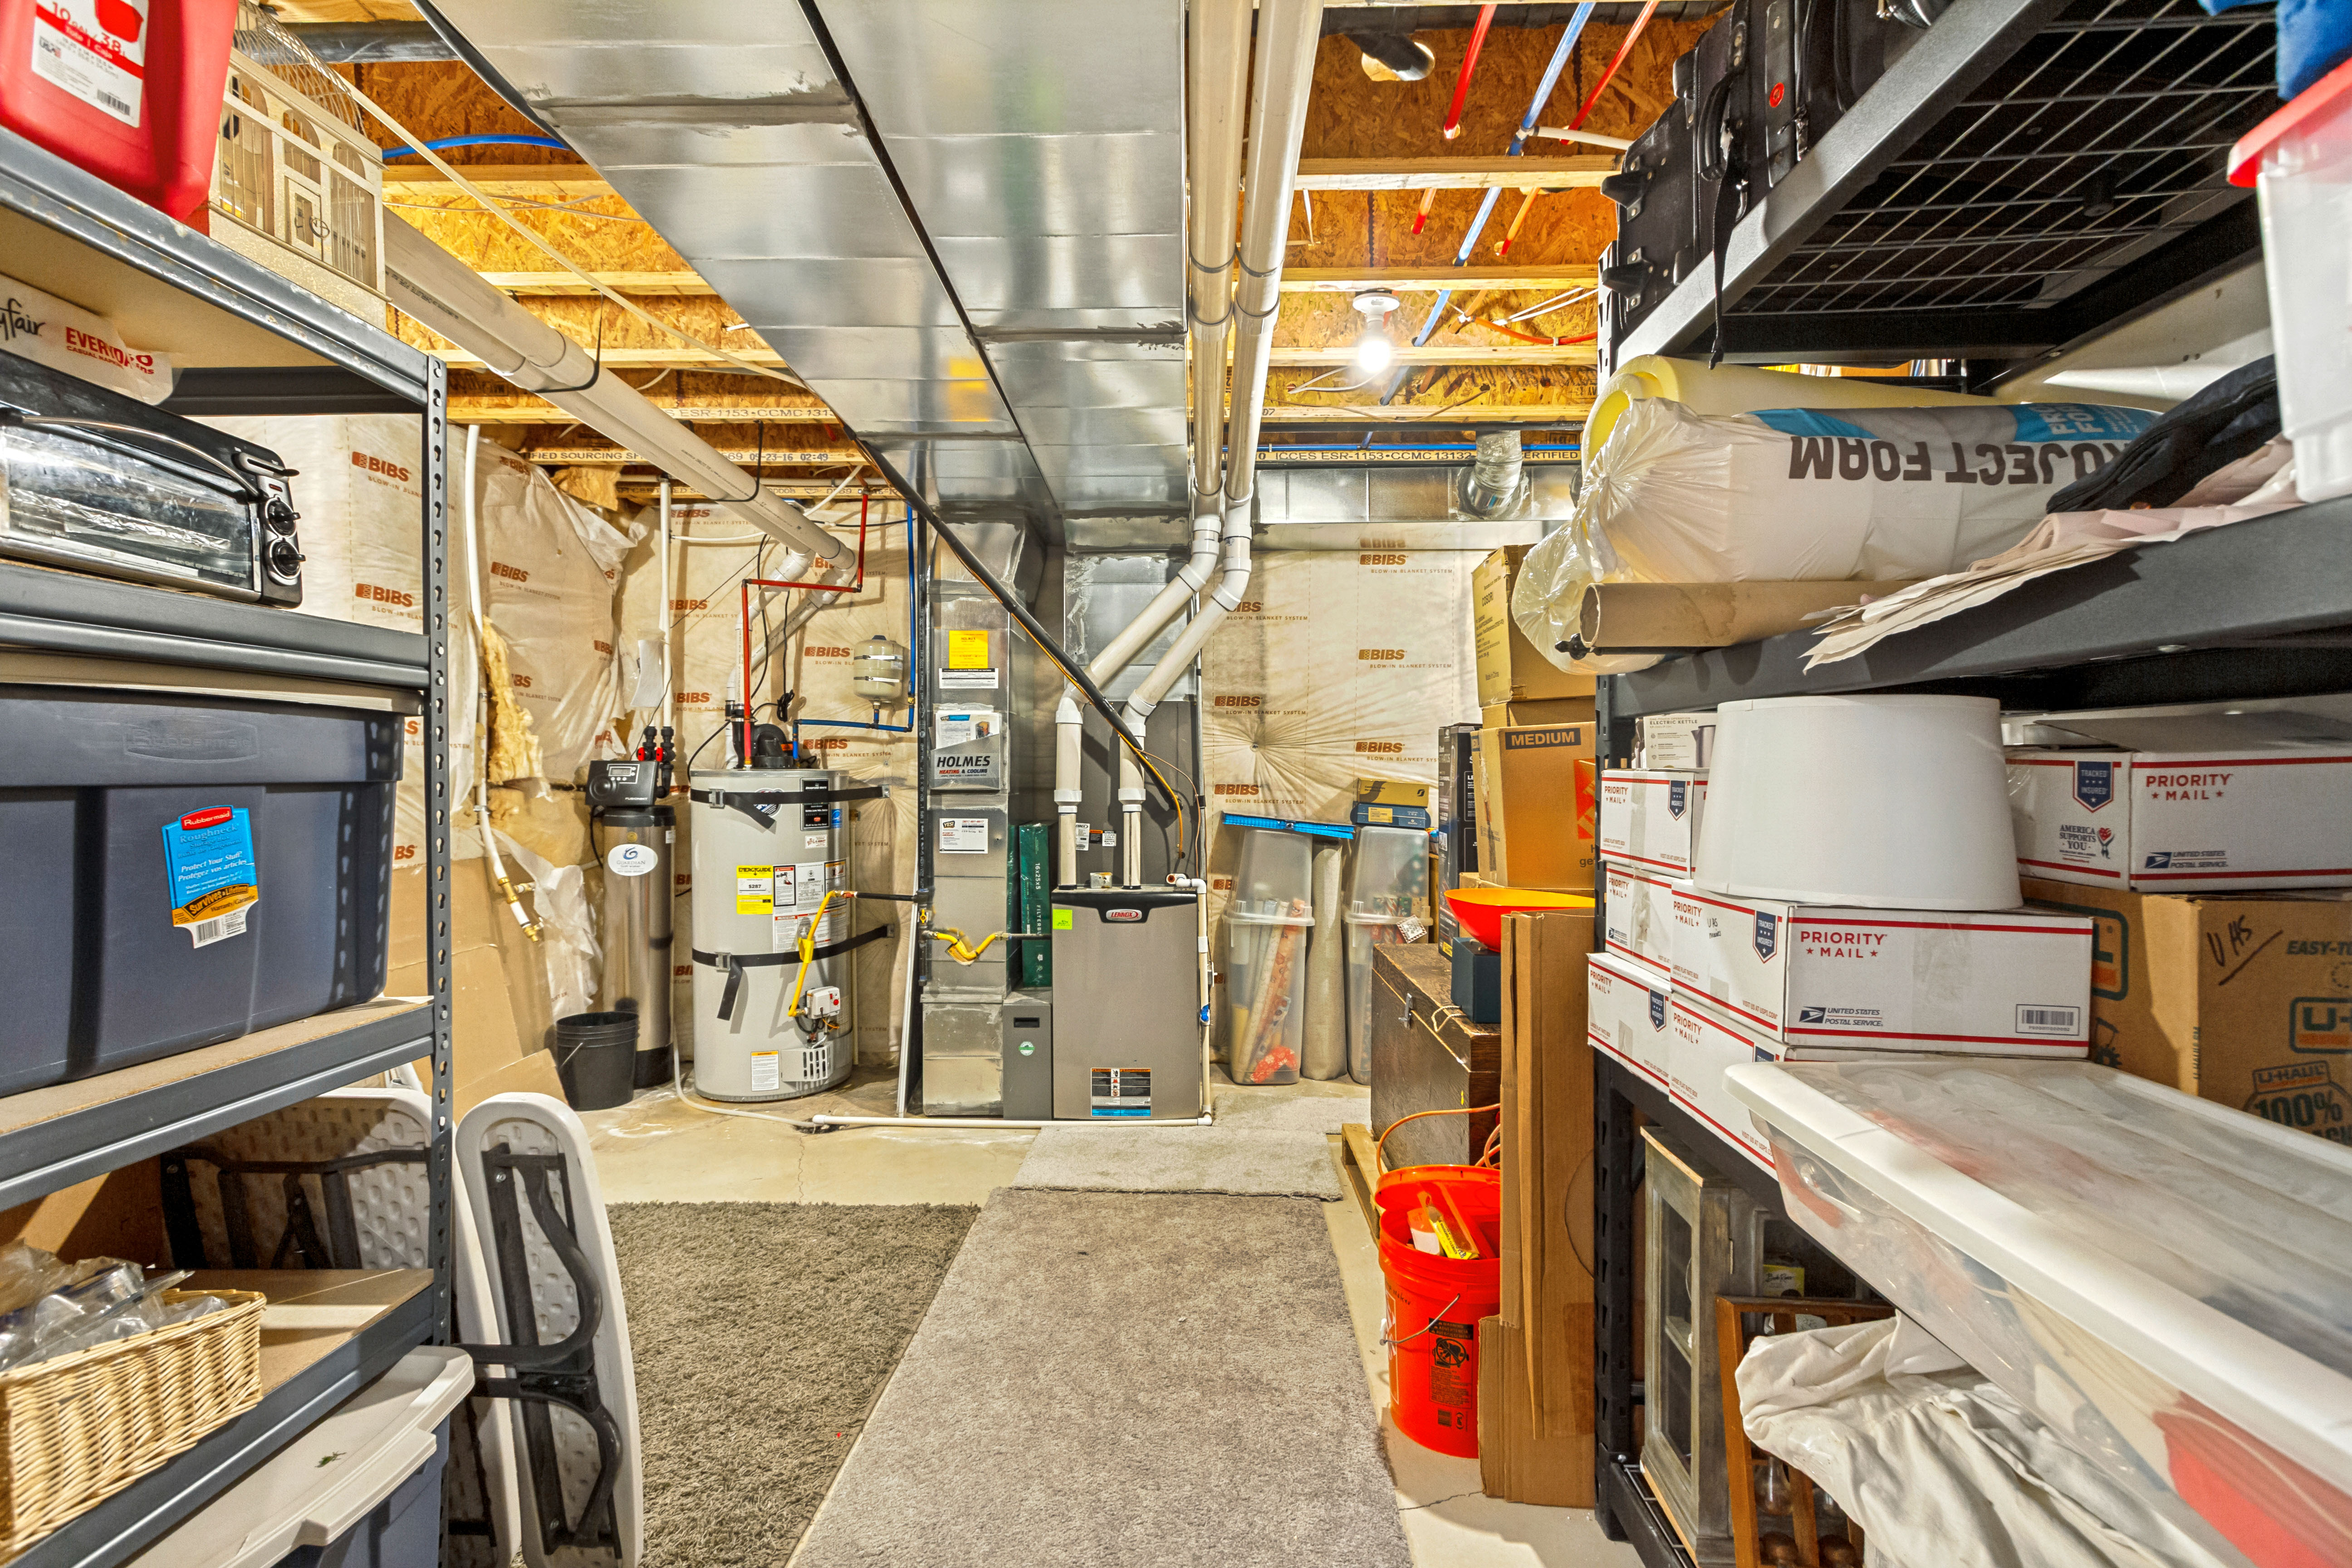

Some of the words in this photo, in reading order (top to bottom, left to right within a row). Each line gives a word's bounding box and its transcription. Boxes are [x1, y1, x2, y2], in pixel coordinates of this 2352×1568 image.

[800, 453, 828, 461] 02:49
[1392, 452, 1433, 460] CCMC
[1789, 436, 1933, 482] FOAM
[368, 456, 410, 482] BIBS
[368, 475, 400, 490] BLOW-IN
[677, 510, 710, 518] BIBS
[1371, 554, 1406, 565] BIBS
[500, 564, 529, 583] BIBS
[372, 585, 413, 608] BIBS
[676, 599, 708, 610] BIBS
[372, 606, 404, 617] BLOW-IN
[816, 647, 850, 657] BIBS
[1370, 649, 1405, 660] BIBS
[676, 693, 710, 703] BIBS
[1225, 696, 1260, 707] BIBS
[813, 739, 848, 749] BIBS
[1511, 731, 1575, 746] MEDIUM
[1368, 742, 1403, 753] BIBS
[936, 755, 991, 768] HOLMES
[2081, 769, 2107, 778] TRACKED
[2146, 773, 2232, 788] PRIORITY
[1225, 784, 1259, 795] BIBS
[1604, 785, 1628, 796] PRIORITY
[2081, 786, 2107, 795] INSURED
[2166, 790, 2209, 801] MAIL
[184, 811, 230, 827] Rubbermaid
[179, 823, 237, 844] Roughneck
[2060, 824, 2096, 835] AMERICA
[2059, 832, 2097, 843] SUPPORTS
[2066, 841, 2087, 851] YOU
[181, 861, 207, 873] Protect
[208, 857, 224, 866] Your
[178, 867, 209, 882] Protégez
[1608, 877, 1630, 890] PRIORITY
[1612, 889, 1623, 898] MAIL
[188, 891, 223, 915] Survives
[1674, 901, 1702, 917] PRIORITY
[1680, 915, 1695, 926] MAIL
[1758, 919, 1774, 930] TRACKED
[1800, 930, 1885, 946] PRIORITY
[1820, 947, 1864, 958] MAIL
[1590, 970, 1612, 987] PRIORITY
[1594, 982, 1607, 994] MAIL
[1673, 1012, 1702, 1036] PRIORITY
[1679, 1028, 1694, 1044] MAIL
[2258, 1063, 2325, 1084] U-HAUL
